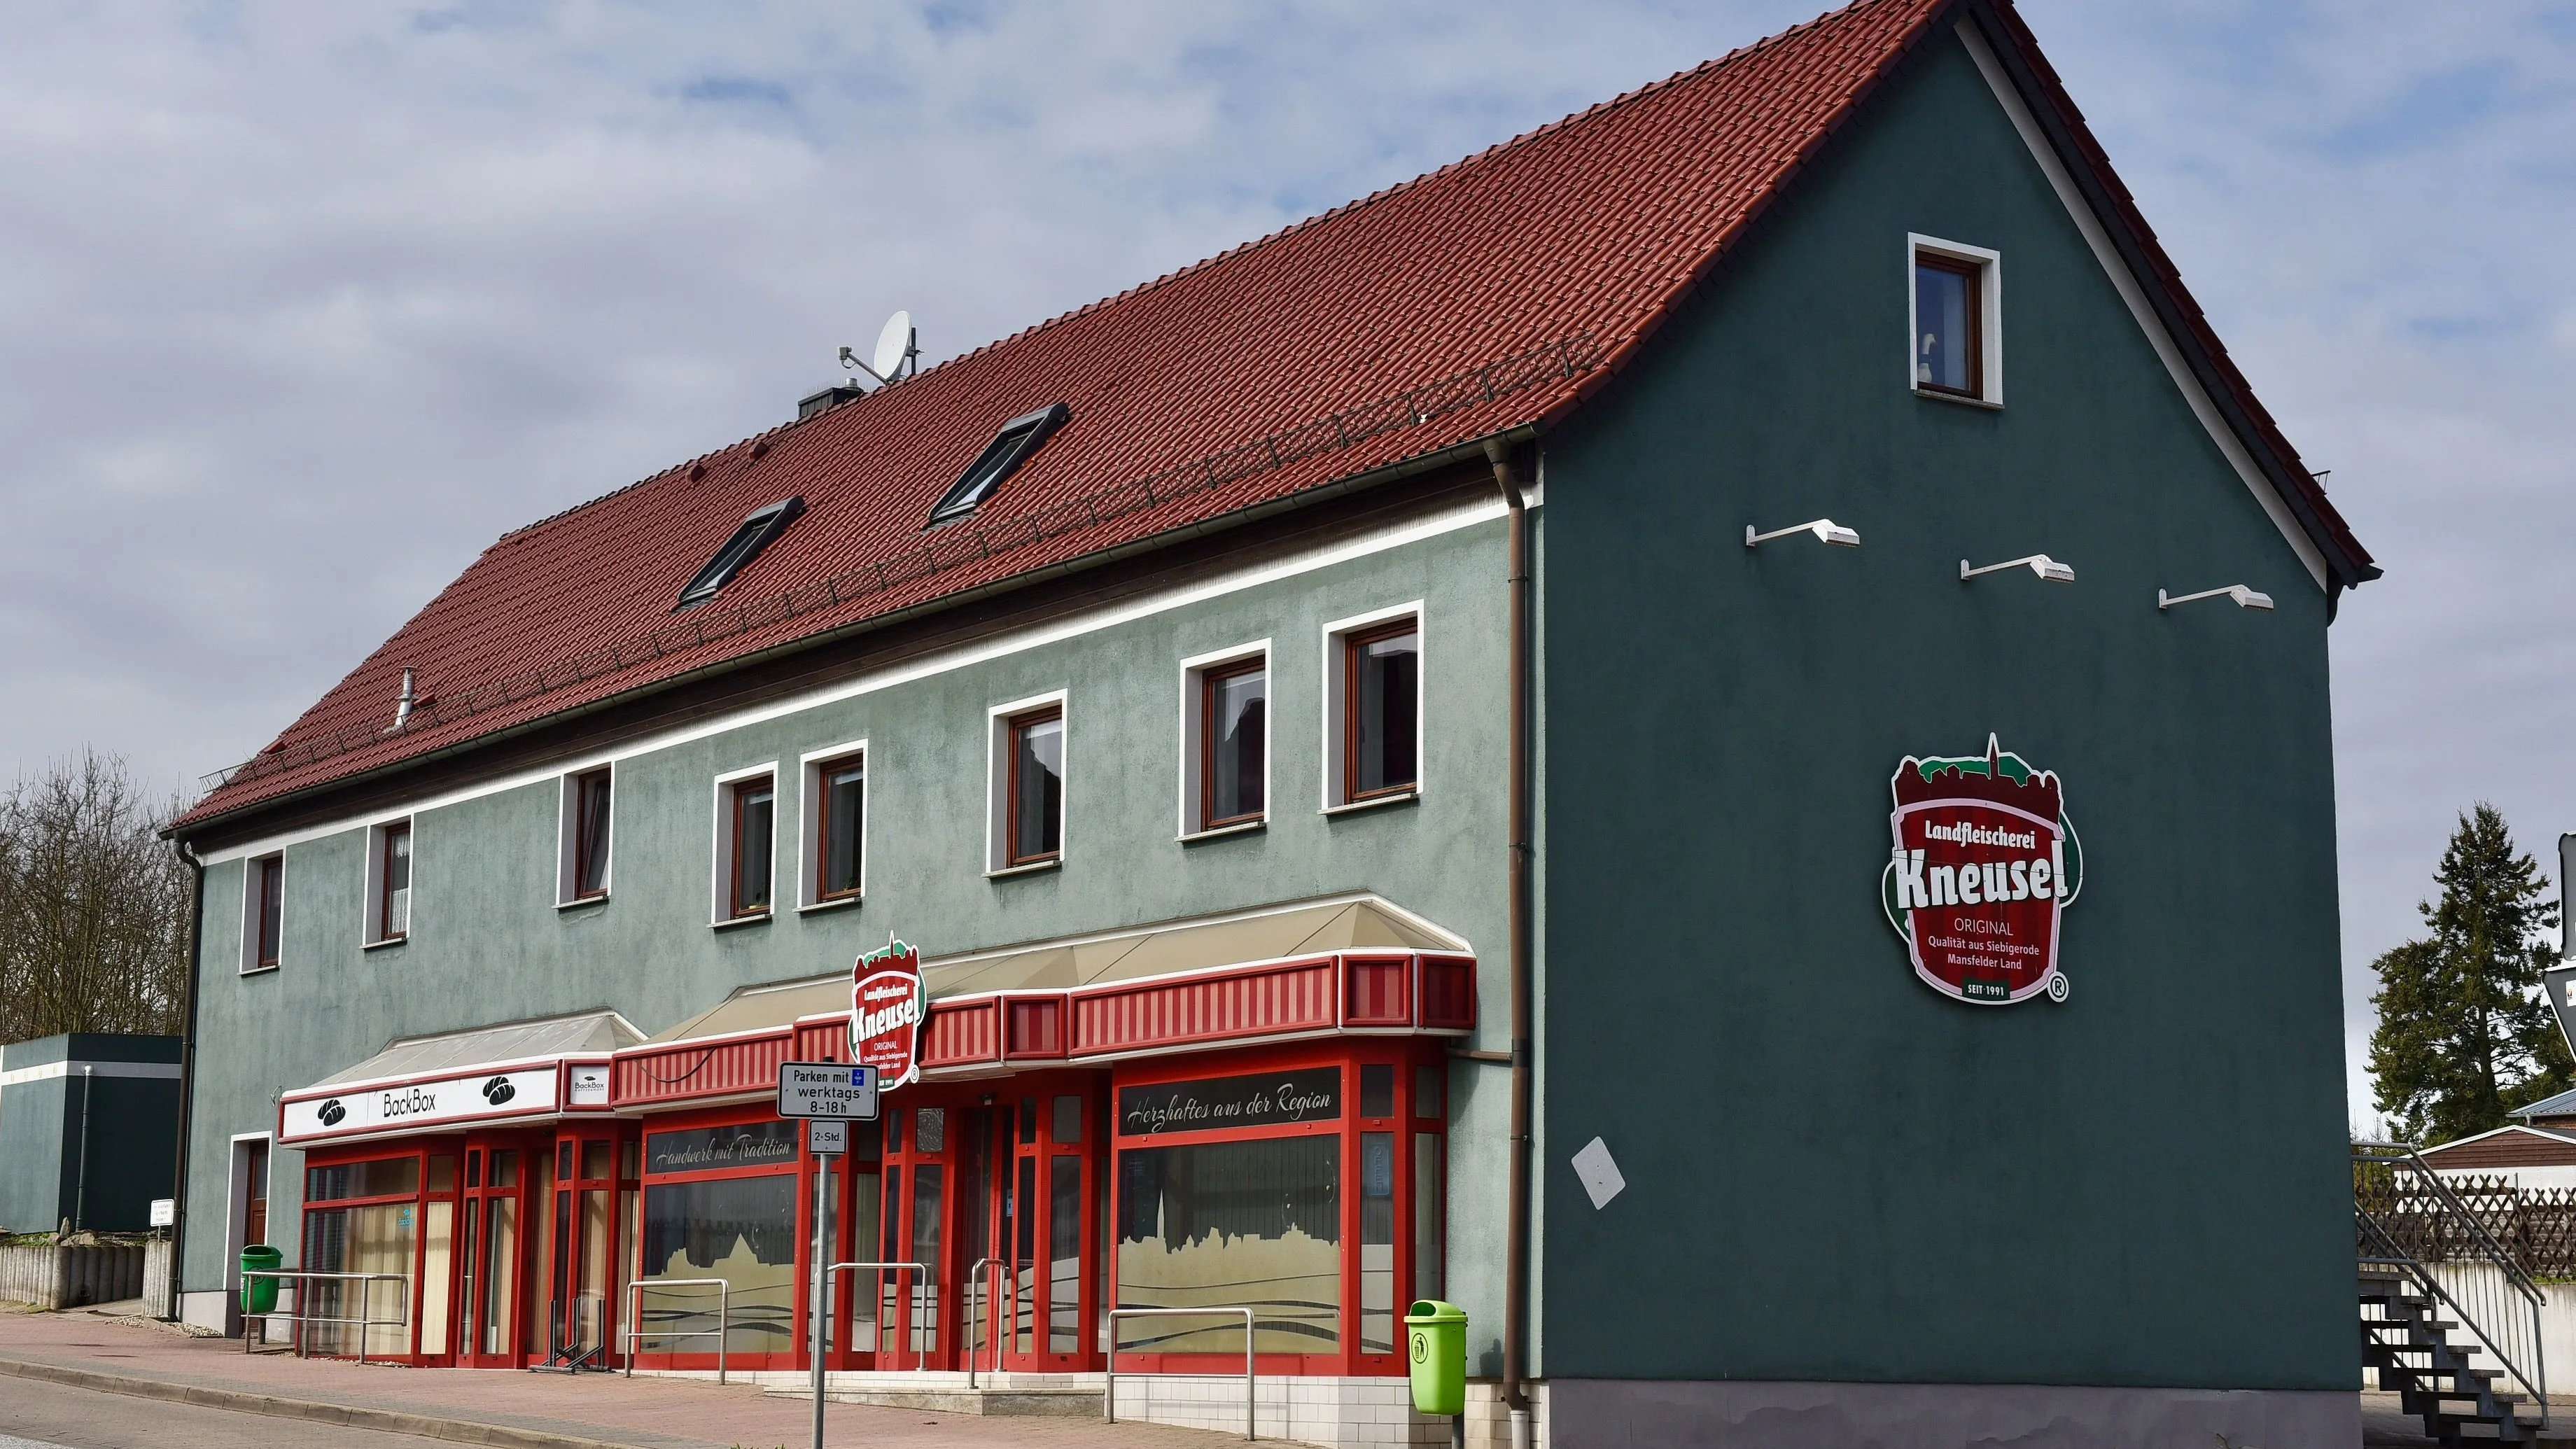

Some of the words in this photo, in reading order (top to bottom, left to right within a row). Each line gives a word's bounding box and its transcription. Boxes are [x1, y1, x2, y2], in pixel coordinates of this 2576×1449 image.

[1926, 820, 2035, 849] Landfleischerei
[1895, 840, 2068, 909] Kneusel
[1954, 918, 2013, 936] ORIGINAL
[1928, 936, 1966, 948] Qualität
[1968, 941, 1984, 951] aus
[1987, 941, 2039, 955] Siebigerode
[1947, 953, 1998, 967] Mansfelder
[2001, 959, 2022, 969] Land
[864, 983, 907, 1002] Landfleischerei
[1968, 984, 1982, 994] SEIT
[1987, 986, 2003, 996] 1991
[853, 986, 920, 1044] Kneusel
[874, 1041, 897, 1051] ORIGINAL
[864, 1054, 878, 1063] Qualität
[886, 1051, 908, 1060] Siebigerode
[794, 1070, 827, 1082] Parken
[833, 1071, 849, 1083] mit
[384, 1088, 435, 1117] BackBox
[798, 1086, 860, 1101] werktags
[841, 1102, 846, 1113] h
[1128, 1095, 1210, 1133] Herzhaftes
[1214, 1102, 1242, 1117] aus
[1246, 1093, 1272, 1116] der
[1275, 1083, 1331, 1120] Region
[815, 1132, 820, 1140] 2
[825, 1132, 841, 1141] Std.
[656, 1138, 715, 1169] Handwerk
[715, 1142, 734, 1160] mit
[736, 1134, 790, 1161] Tradition
